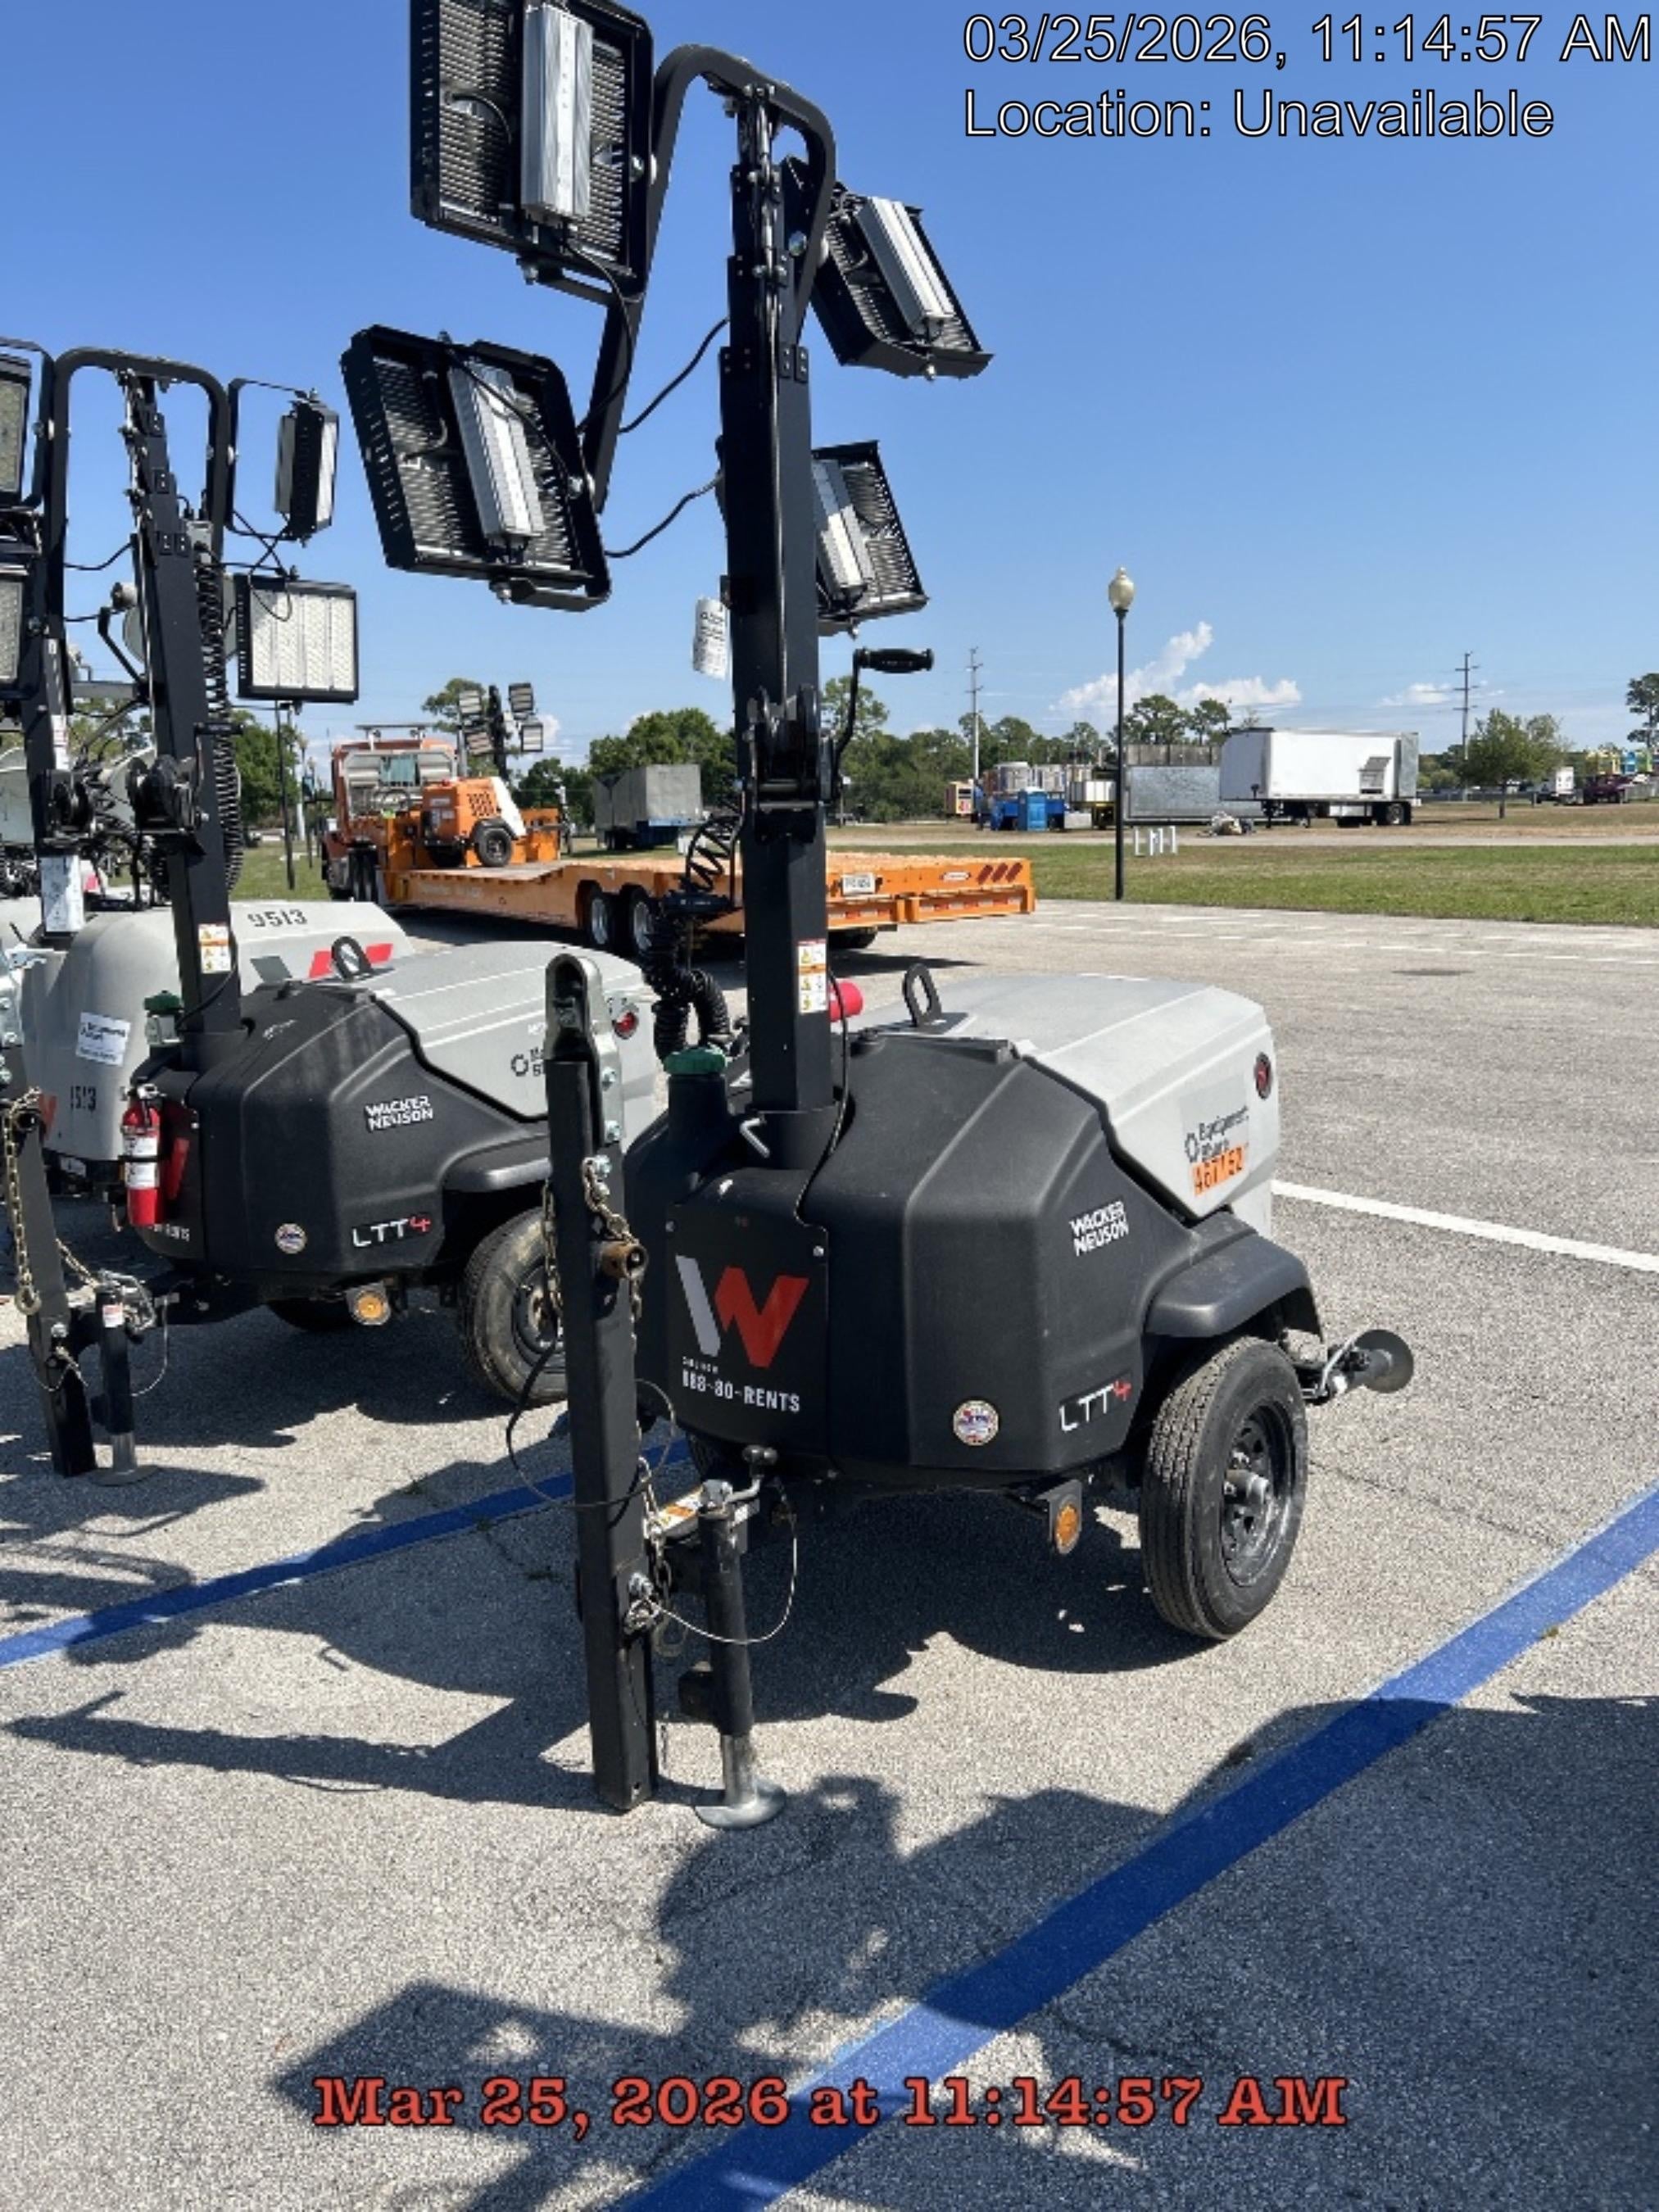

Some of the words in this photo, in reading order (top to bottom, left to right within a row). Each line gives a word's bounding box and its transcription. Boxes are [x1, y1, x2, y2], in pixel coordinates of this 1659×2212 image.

[247, 909, 307, 927] 9513
[365, 1095, 431, 1117] WACKER
[369, 1107, 433, 1131] NEUSON
[1069, 1199, 1126, 1237] WACKER
[1073, 1217, 1130, 1258] NEUSON
